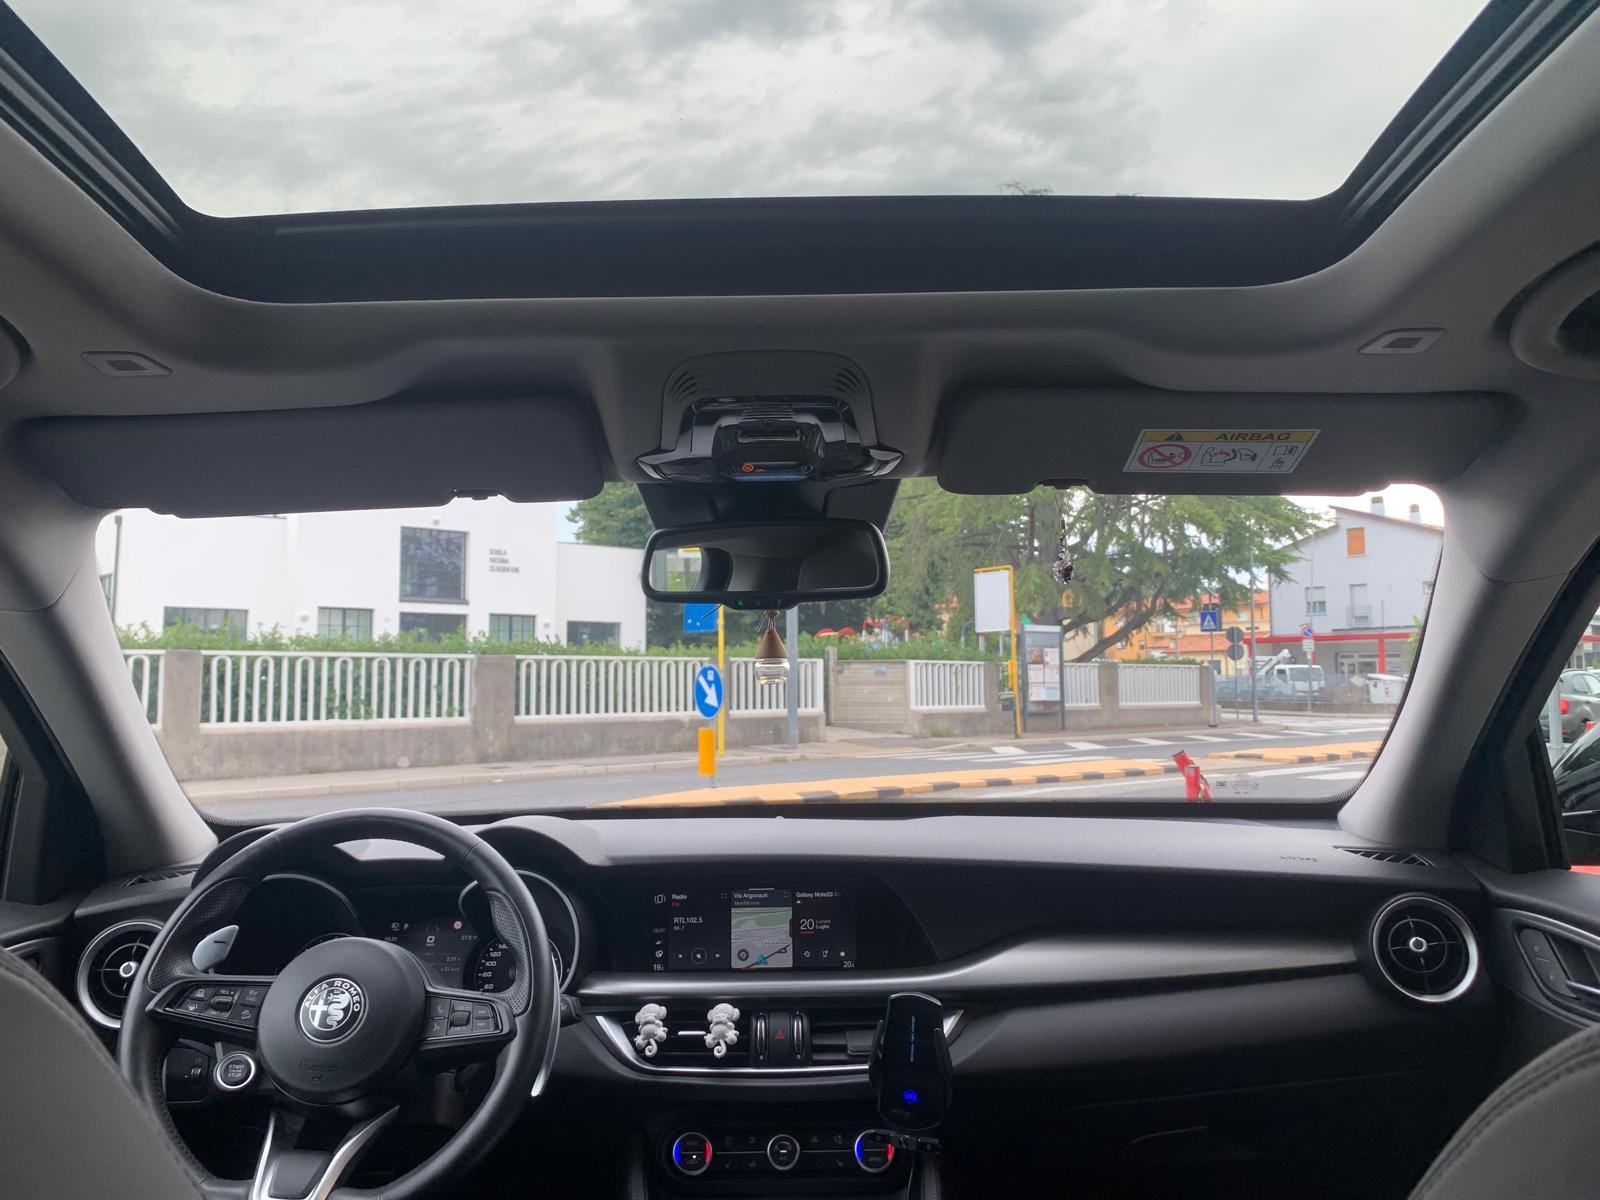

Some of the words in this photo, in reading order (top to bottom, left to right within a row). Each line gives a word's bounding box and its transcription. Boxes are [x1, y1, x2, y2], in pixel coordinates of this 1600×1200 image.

[1214, 432, 1292, 441] AIRBAG
[673, 916, 703, 924] RTL102.5
[799, 918, 815, 930] 20
[403, 923, 409, 931] P
[304, 983, 330, 1008] ALFA
[333, 980, 361, 1012] ROMEO
